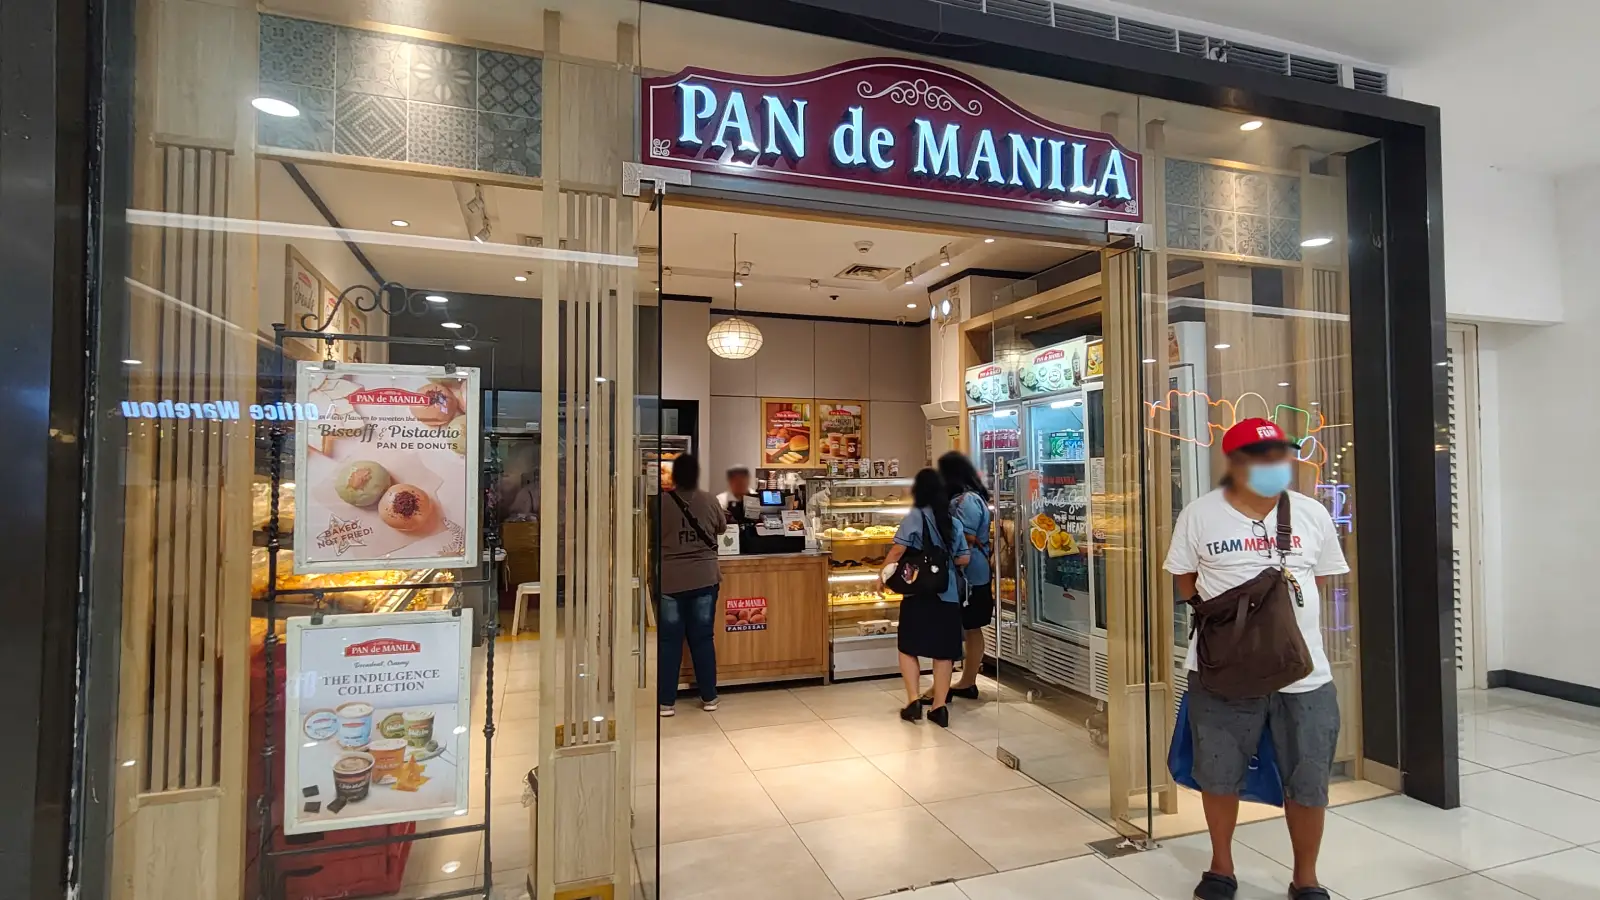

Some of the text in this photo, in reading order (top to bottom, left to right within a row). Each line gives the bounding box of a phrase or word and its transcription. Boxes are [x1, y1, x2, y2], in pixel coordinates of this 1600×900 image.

[678, 82, 1133, 200] PAN de MANILA
[356, 394, 426, 404] PAN de MANILA
[318, 423, 379, 442] Biscoff
[388, 424, 461, 439] Pistachio
[377, 442, 459, 450] PAN DE DONUTS
[317, 526, 374, 549] NOT FRIED!
[679, 531, 699, 545] FIS
[1206, 535, 1302, 556] TEAM MEMR
[351, 647, 369, 655] PAN
[382, 643, 416, 653] MANILA
[322, 669, 441, 686] THE INDULGENCE
[338, 681, 425, 697] COLLECTION
